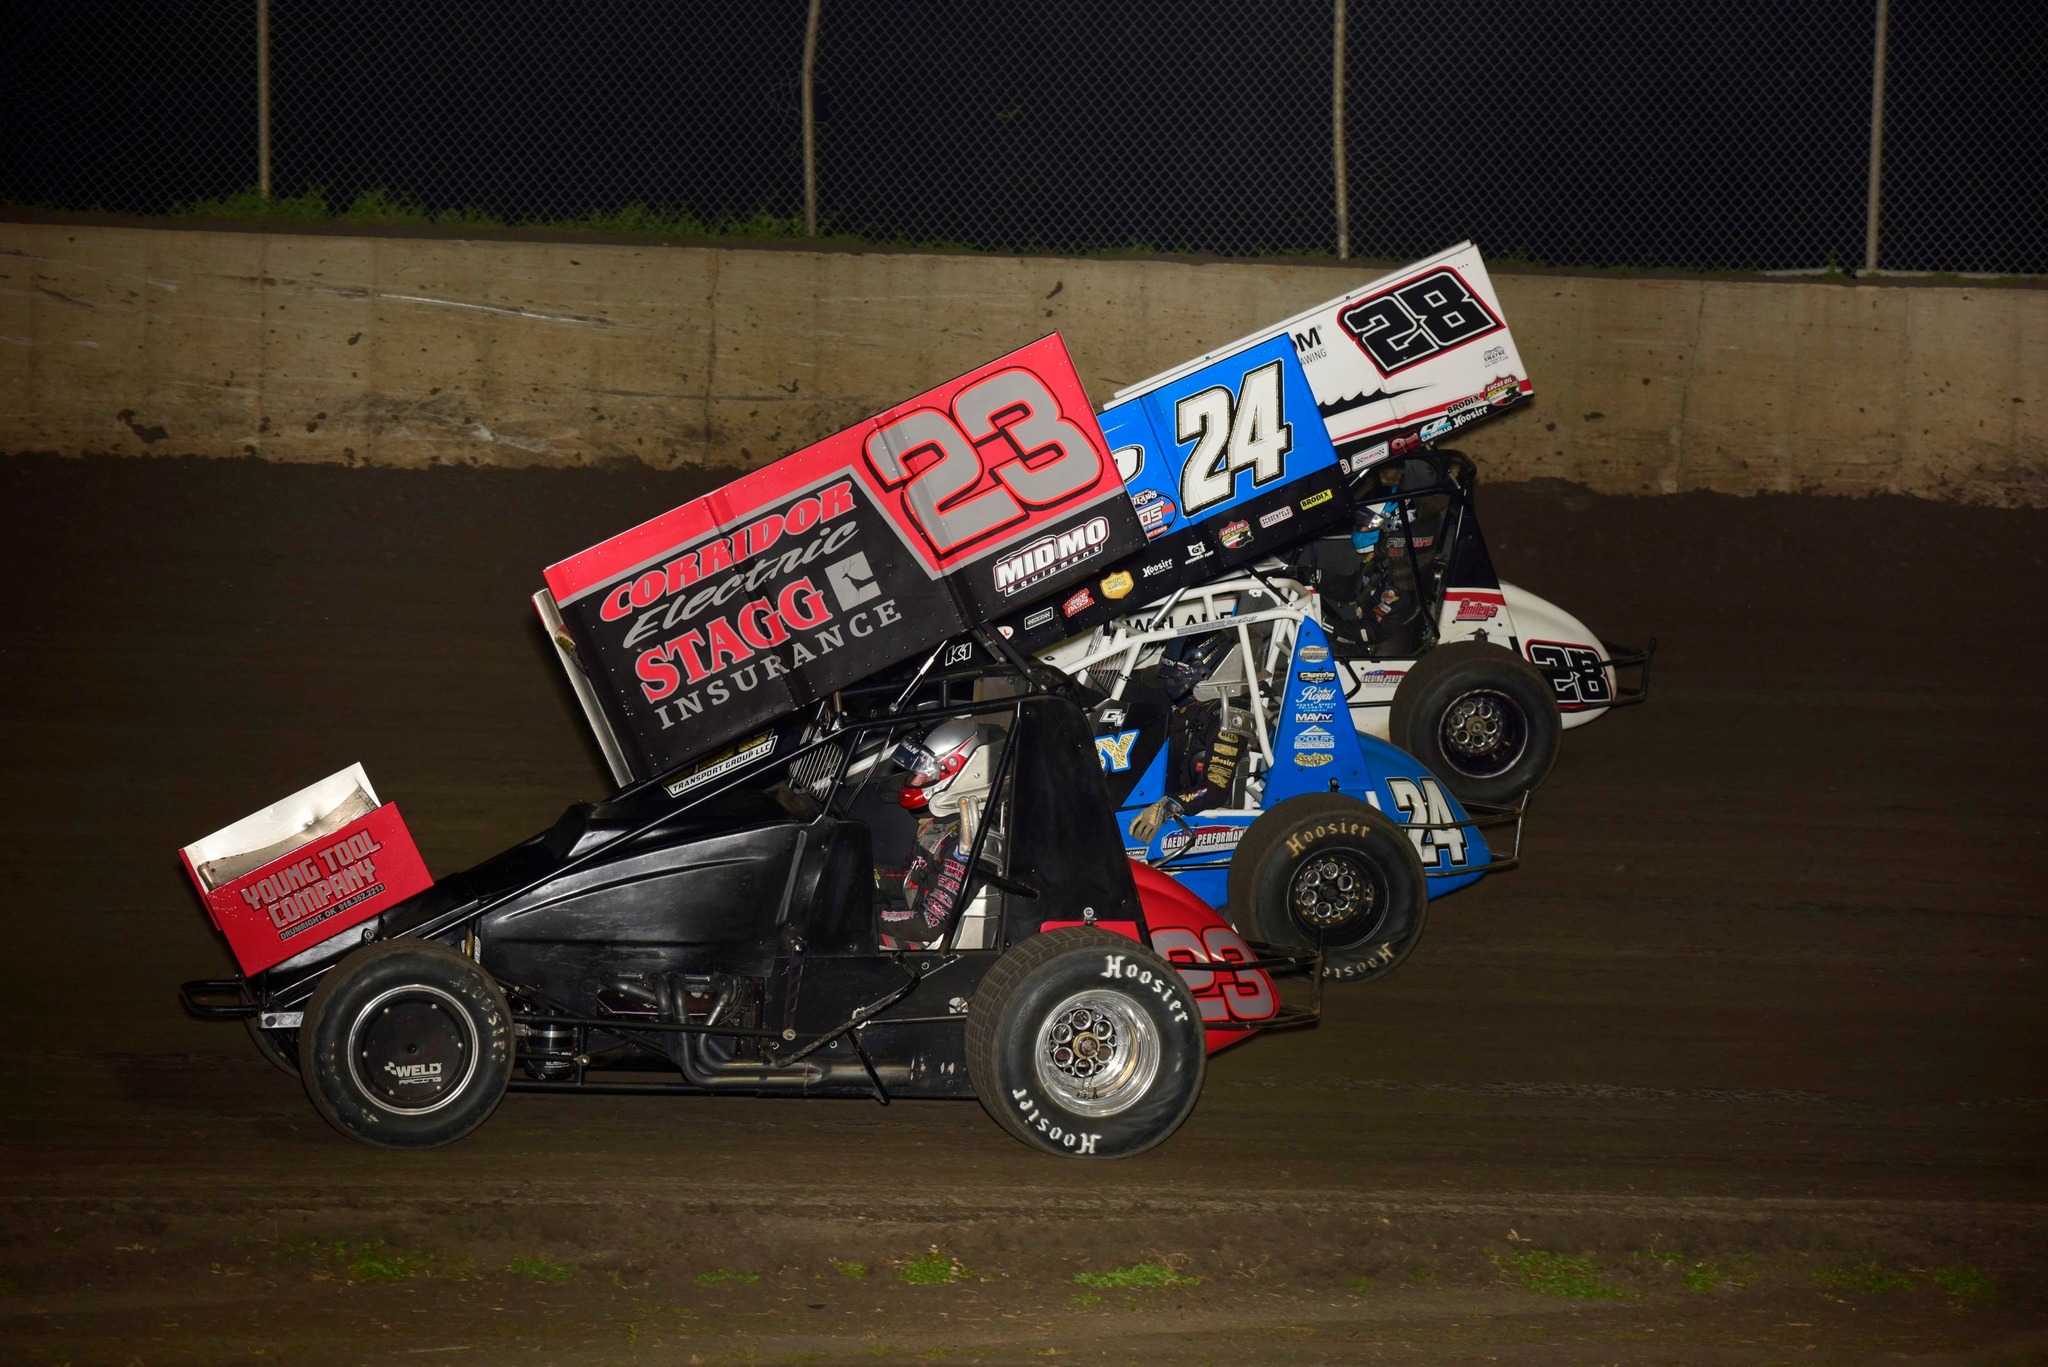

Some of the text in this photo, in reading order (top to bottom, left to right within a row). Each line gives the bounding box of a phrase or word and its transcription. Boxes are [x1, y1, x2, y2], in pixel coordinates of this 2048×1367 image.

[1342, 271, 1497, 373] 28
[1447, 393, 1480, 414] BRODIX
[1453, 406, 1488, 428] Hoosier
[1176, 359, 1293, 518] 24
[1422, 425, 1453, 442] CARRILLO
[862, 366, 1104, 559] 23
[1301, 491, 1329, 507] BRODIX
[600, 481, 857, 622] CORRIDOR
[1221, 525, 1237, 536] LUCAS
[1237, 521, 1246, 529] OIL
[997, 518, 1107, 589] MID MO
[1007, 546, 1101, 594] Equipment
[1142, 558, 1173, 578] Hoosier
[623, 521, 860, 649] Electric
[1068, 597, 1089, 615] PASS
[635, 576, 833, 703] STAGG
[945, 642, 972, 667] K1
[654, 599, 902, 730] INSURANCE
[1528, 643, 1612, 704] 28
[1296, 685, 1337, 704] Royal
[1294, 735, 1335, 743] SCHOOLER'S
[672, 743, 771, 792] TRANSPORT GROUP LLC
[1162, 830, 1246, 849] KAEDIN PERFORMAN
[1286, 818, 1371, 858] Hoosier
[1384, 776, 1470, 869] 24
[240, 829, 382, 911] YOUNG TOOL
[268, 858, 376, 929] COMPANY
[280, 914, 325, 941] DRUMRIGHT,
[324, 908, 338, 919] OK
[1150, 926, 1280, 1022] 23
[1321, 942, 1395, 978] Hoosie
[1100, 955, 1189, 1024] Hoosier
[396, 1063, 442, 1078] WELD
[399, 1077, 442, 1085] RACING
[1012, 1087, 1103, 1154] Hoosier
